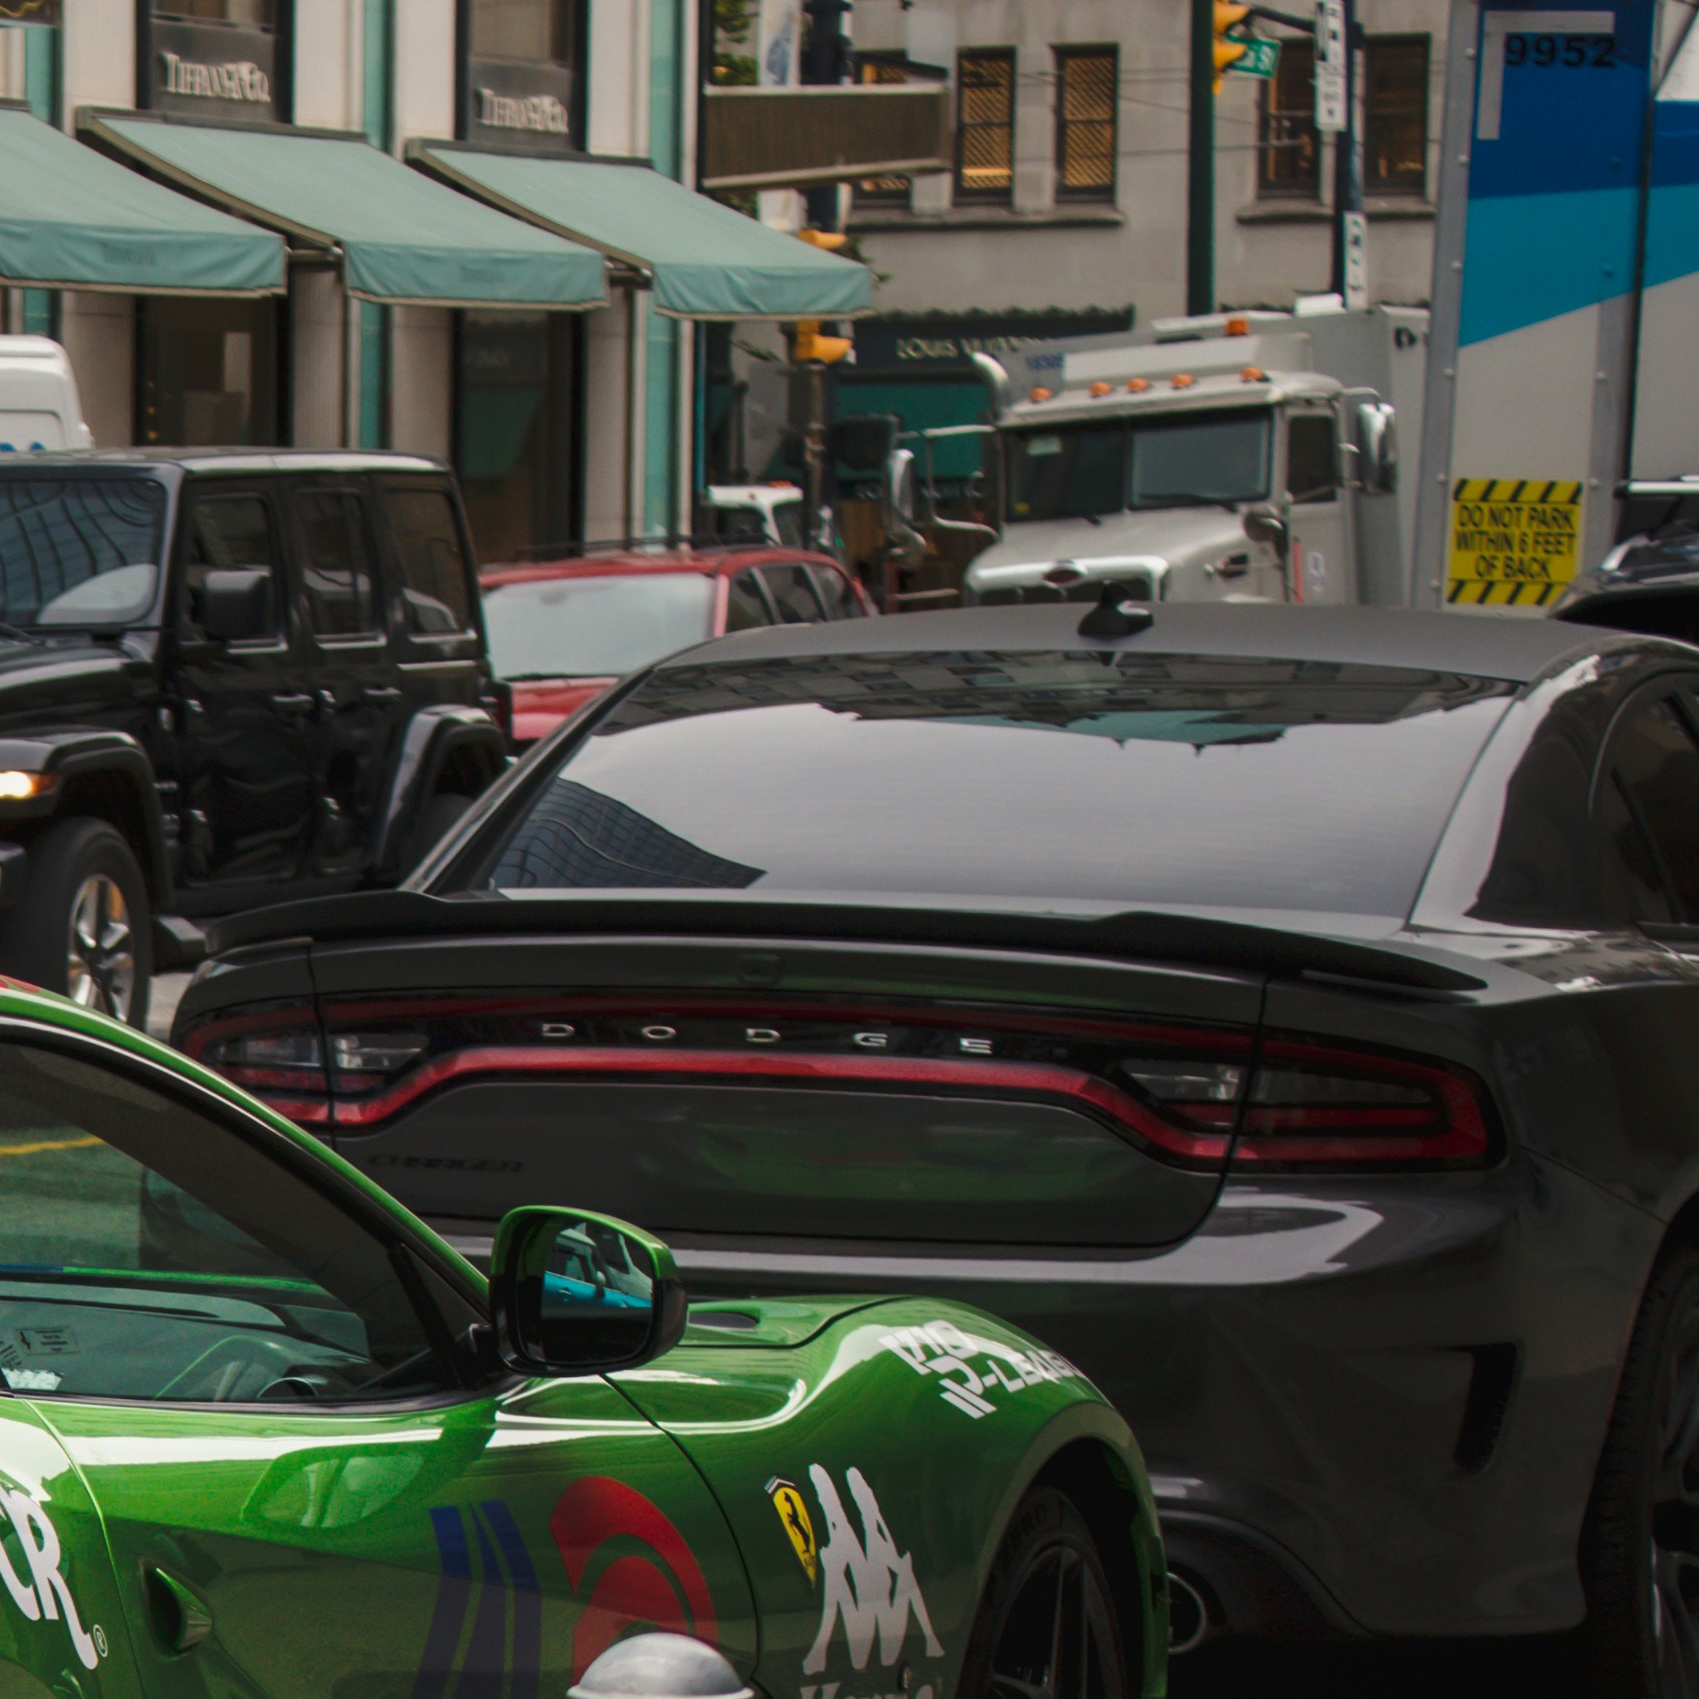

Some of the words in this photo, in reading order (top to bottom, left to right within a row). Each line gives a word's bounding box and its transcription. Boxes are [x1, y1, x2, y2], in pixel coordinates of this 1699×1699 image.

[1503, 34, 1617, 68] 9952
[1459, 504, 1484, 528] DO
[1488, 505, 1524, 529] NOT
[1528, 506, 1574, 531] PARK
[1455, 530, 1514, 552] WITHIN
[1519, 531, 1530, 553] 6
[1533, 532, 1577, 555] FEET
[1475, 554, 1500, 578] OF
[1504, 556, 1550, 580] BACK
[541, 1023, 994, 1055] DODGE
